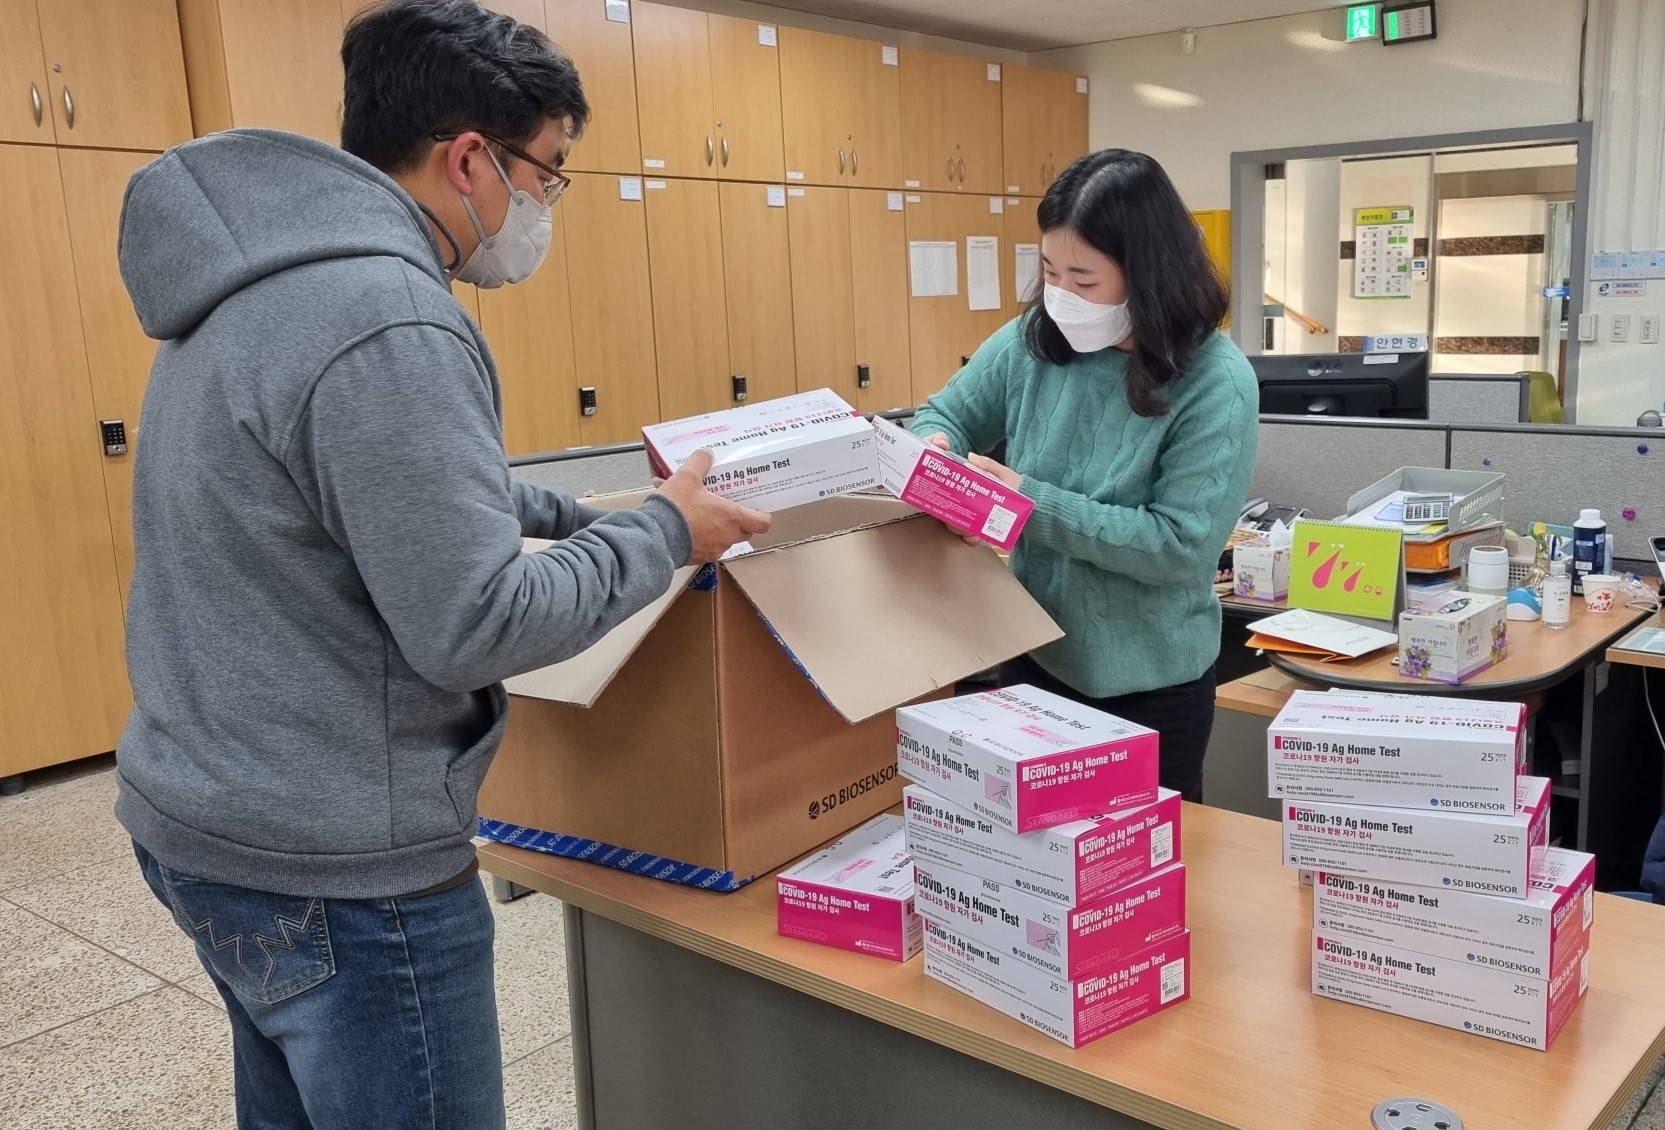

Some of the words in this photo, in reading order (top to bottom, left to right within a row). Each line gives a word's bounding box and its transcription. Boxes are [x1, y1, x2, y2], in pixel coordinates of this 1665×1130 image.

[1377, 337, 1418, 349] 안현경
[791, 412, 849, 428] COVID-19
[732, 431, 768, 442] Home
[703, 473, 730, 485] VID-19
[734, 470, 744, 479] Ag
[746, 464, 770, 476] Home
[772, 458, 790, 469] Test
[928, 460, 960, 481] COVID-19
[960, 476, 970, 488] Ag
[971, 482, 989, 496] Home
[991, 491, 1005, 503] Test
[837, 479, 875, 493] BIOSENSOR
[900, 734, 929, 758] COVID-19
[932, 749, 940, 766] Ag
[943, 753, 962, 773] Home
[964, 763, 979, 781] Test
[1282, 740, 1328, 752] COVID-19
[1332, 744, 1344, 755] Ag
[1348, 745, 1376, 756] Home
[1379, 746, 1400, 757] Test
[1481, 753, 1494, 761] 25
[1030, 762, 1070, 780] COVID-19
[1072, 760, 1083, 771] Ag
[1086, 755, 1108, 768] Home
[1111, 750, 1128, 762] Test
[1283, 753, 1312, 761] 코로나19
[1314, 754, 1327, 763] 항원
[1330, 756, 1343, 764] 자가
[1346, 757, 1359, 765] 검사
[997, 765, 1003, 775] 25
[822, 794, 837, 813] SD
[1453, 801, 1505, 810] BIOSENSOR
[913, 800, 943, 818] COVID-19
[945, 811, 954, 823] Ag
[956, 814, 975, 829] Home
[978, 820, 992, 834] Test
[1296, 811, 1342, 826] COVID-19
[1345, 817, 1357, 829] Ag
[1360, 819, 1388, 831] Home
[1392, 822, 1413, 834] Test
[1084, 833, 1115, 853] COVID-19
[1117, 830, 1125, 842] Ag
[1127, 822, 1144, 835] Home
[1146, 814, 1158, 827] Test
[1297, 824, 1325, 834] 코로나19
[1327, 827, 1341, 836] 항원
[1343, 830, 1356, 838] 자가
[1358, 831, 1372, 840] 검사
[1493, 834, 1506, 844] 25
[1049, 842, 1059, 852] 25
[983, 880, 1000, 892] PASS
[1023, 882, 1031, 891] SD
[1032, 884, 1070, 902] BIOSENSOR
[1326, 876, 1370, 894] COVID-19
[1373, 885, 1384, 899] Ag
[1388, 889, 1414, 903] Home
[1418, 895, 1439, 908] Test
[1452, 879, 1463, 887] SD
[1466, 880, 1518, 894] BIOSENSOR
[783, 886, 817, 901] COVID-19
[819, 894, 828, 905] Ag
[831, 895, 851, 908] Home
[854, 900, 869, 911] Test
[918, 873, 956, 900] COVID-19
[959, 891, 970, 908] Ag
[973, 896, 997, 918] Home
[1000, 908, 1020, 928] Test
[1080, 906, 1113, 927] COVID-19
[1115, 903, 1124, 915] Ag
[1126, 895, 1145, 909] Home
[1146, 887, 1161, 900] Test
[1327, 888, 1353, 900] 코로나19
[1356, 895, 1369, 904] 항원
[1370, 898, 1383, 907] 자가
[1386, 900, 1399, 910] 검사
[1042, 913, 1051, 924] 25
[1517, 914, 1530, 924] 25
[930, 924, 956, 944] COVID-19
[958, 938, 965, 952] Ag
[967, 942, 984, 958] Home
[986, 952, 1000, 966] Test
[1019, 950, 1026, 958] SD
[1027, 952, 1062, 974] BIOSENSOR
[1324, 942, 1367, 960] COVID-19
[1370, 953, 1382, 966] Ag
[1385, 956, 1412, 970] Home
[1415, 963, 1436, 976] Test
[1325, 954, 1351, 966] 코로나19
[1353, 960, 1366, 970] 항원
[1368, 964, 1381, 973] 자가
[1383, 967, 1396, 977] 검사
[1477, 955, 1487, 964] SD
[1489, 958, 1541, 975] BIOSENSOR
[1084, 973, 1118, 995] COVID-19
[1120, 970, 1128, 980] Ag
[1131, 961, 1149, 975] Home
[1151, 952, 1165, 966] Test
[1050, 981, 1058, 992] 25
[1513, 985, 1526, 995] 25
[1026, 1016, 1034, 1024] SD
[1035, 1018, 1069, 1041] BIOSENSOR
[1473, 1024, 1484, 1032] SD
[1486, 1027, 1537, 1045] BIOSENSOR
